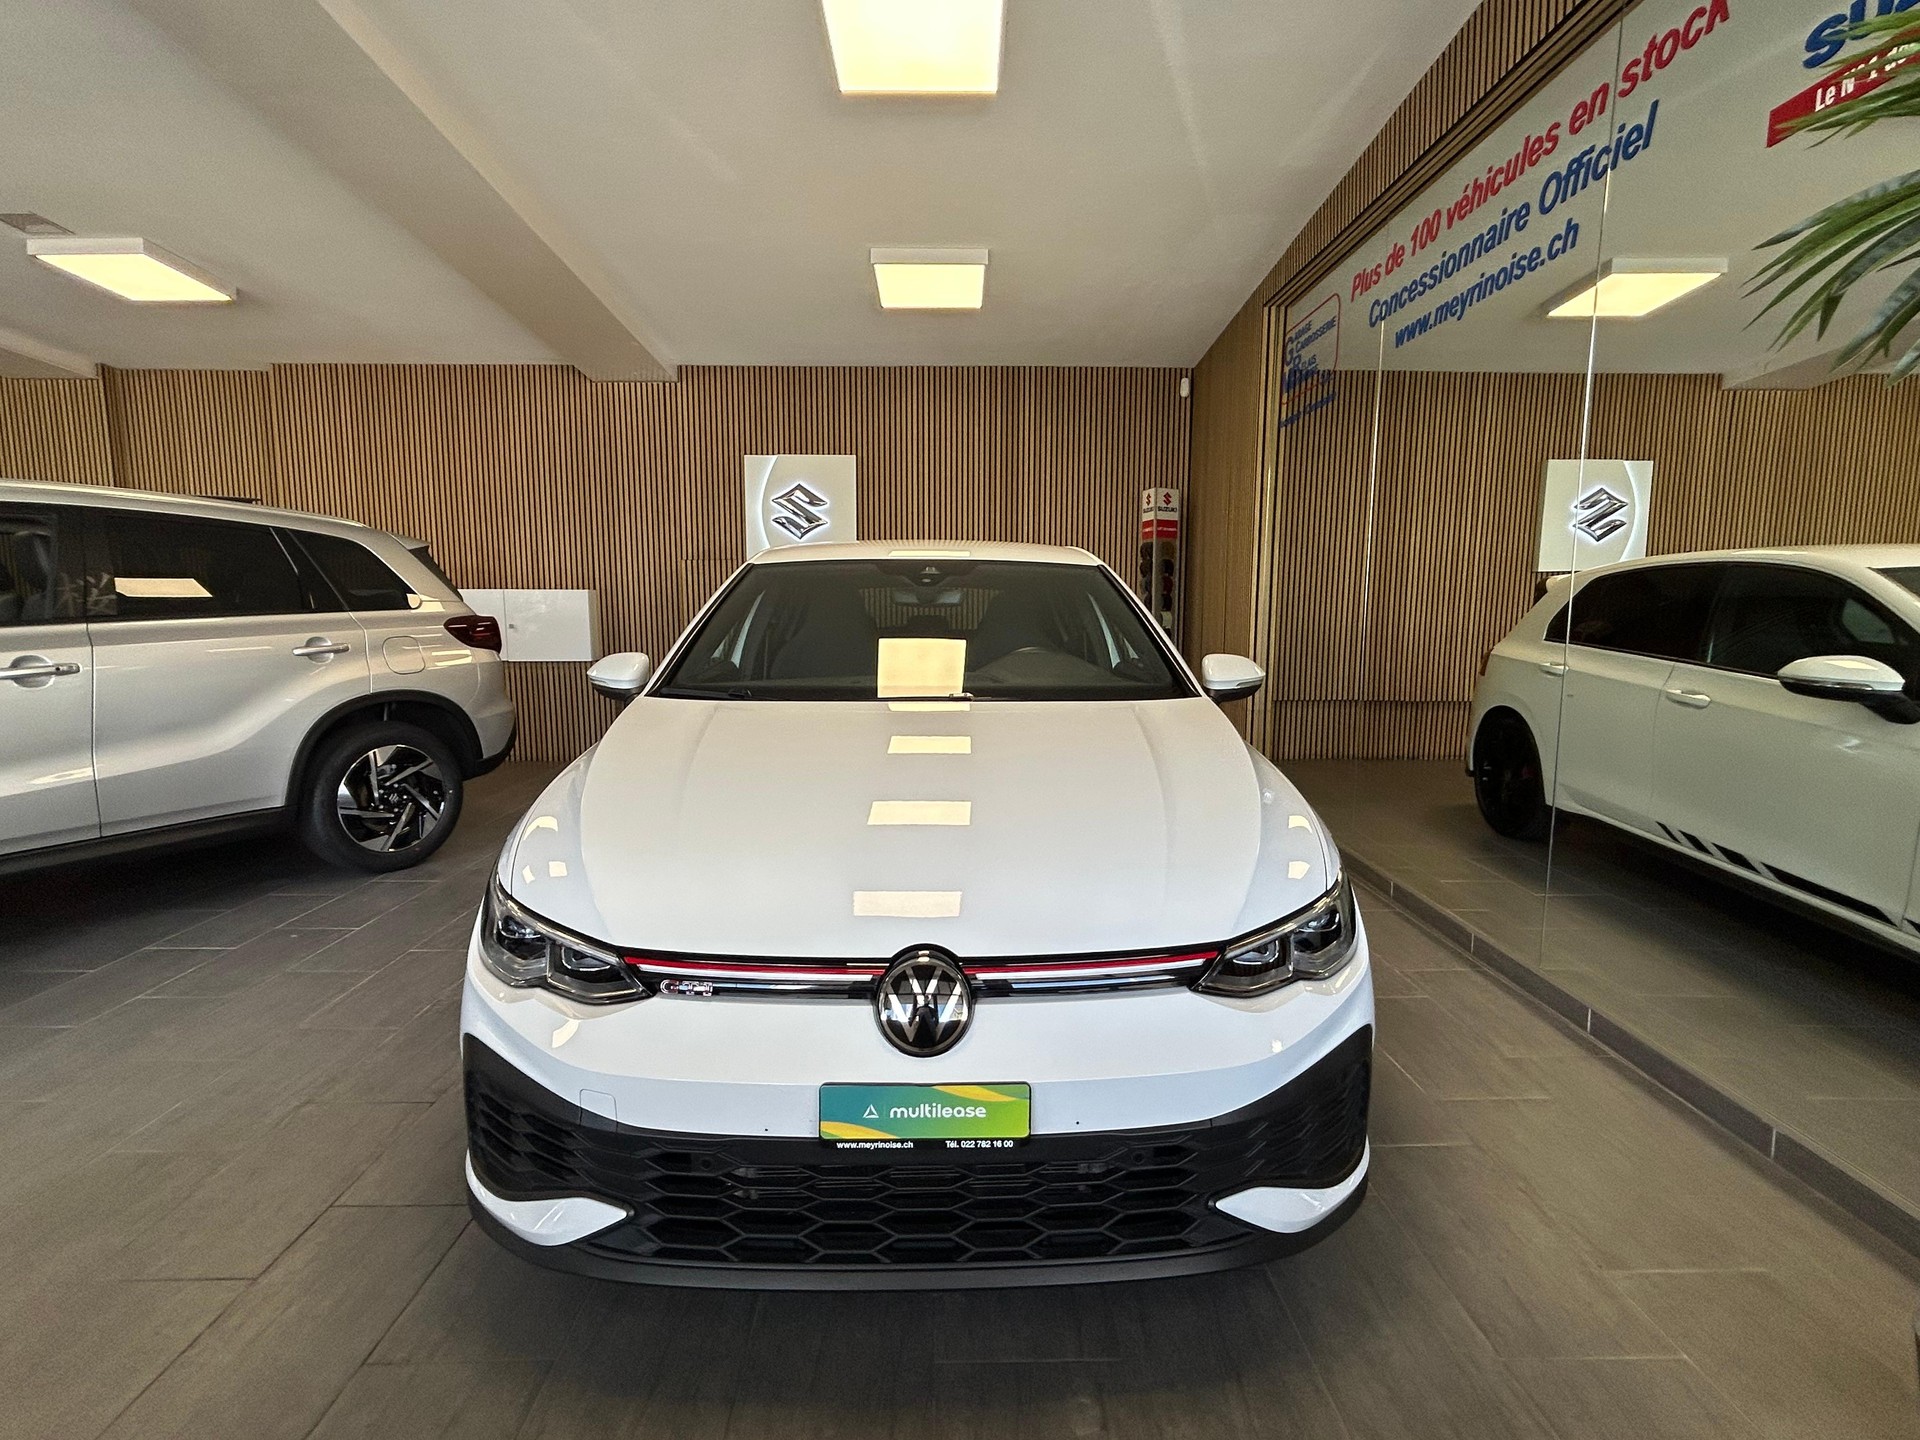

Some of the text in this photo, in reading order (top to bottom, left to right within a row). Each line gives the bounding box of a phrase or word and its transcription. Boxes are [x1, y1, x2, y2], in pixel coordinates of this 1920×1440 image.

[1815, 86, 1836, 112] Le
[1351, 262, 1383, 303] Plus
[1385, 242, 1406, 276] de
[1411, 208, 1442, 257] 100
[1446, 121, 1561, 230] véhicules
[1568, 82, 1610, 136] en
[1369, 99, 1660, 328] Concessionnaire Officiel
[1395, 217, 1580, 348] www.meyrinoise.ch
[889, 1103, 987, 1119] multilease
[836, 1141, 913, 1149] www.meyrinoise.ch
[945, 1140, 959, 1148] Tél.
[961, 1140, 975, 1148] 022
[1003, 1140, 1014, 1148] 00
